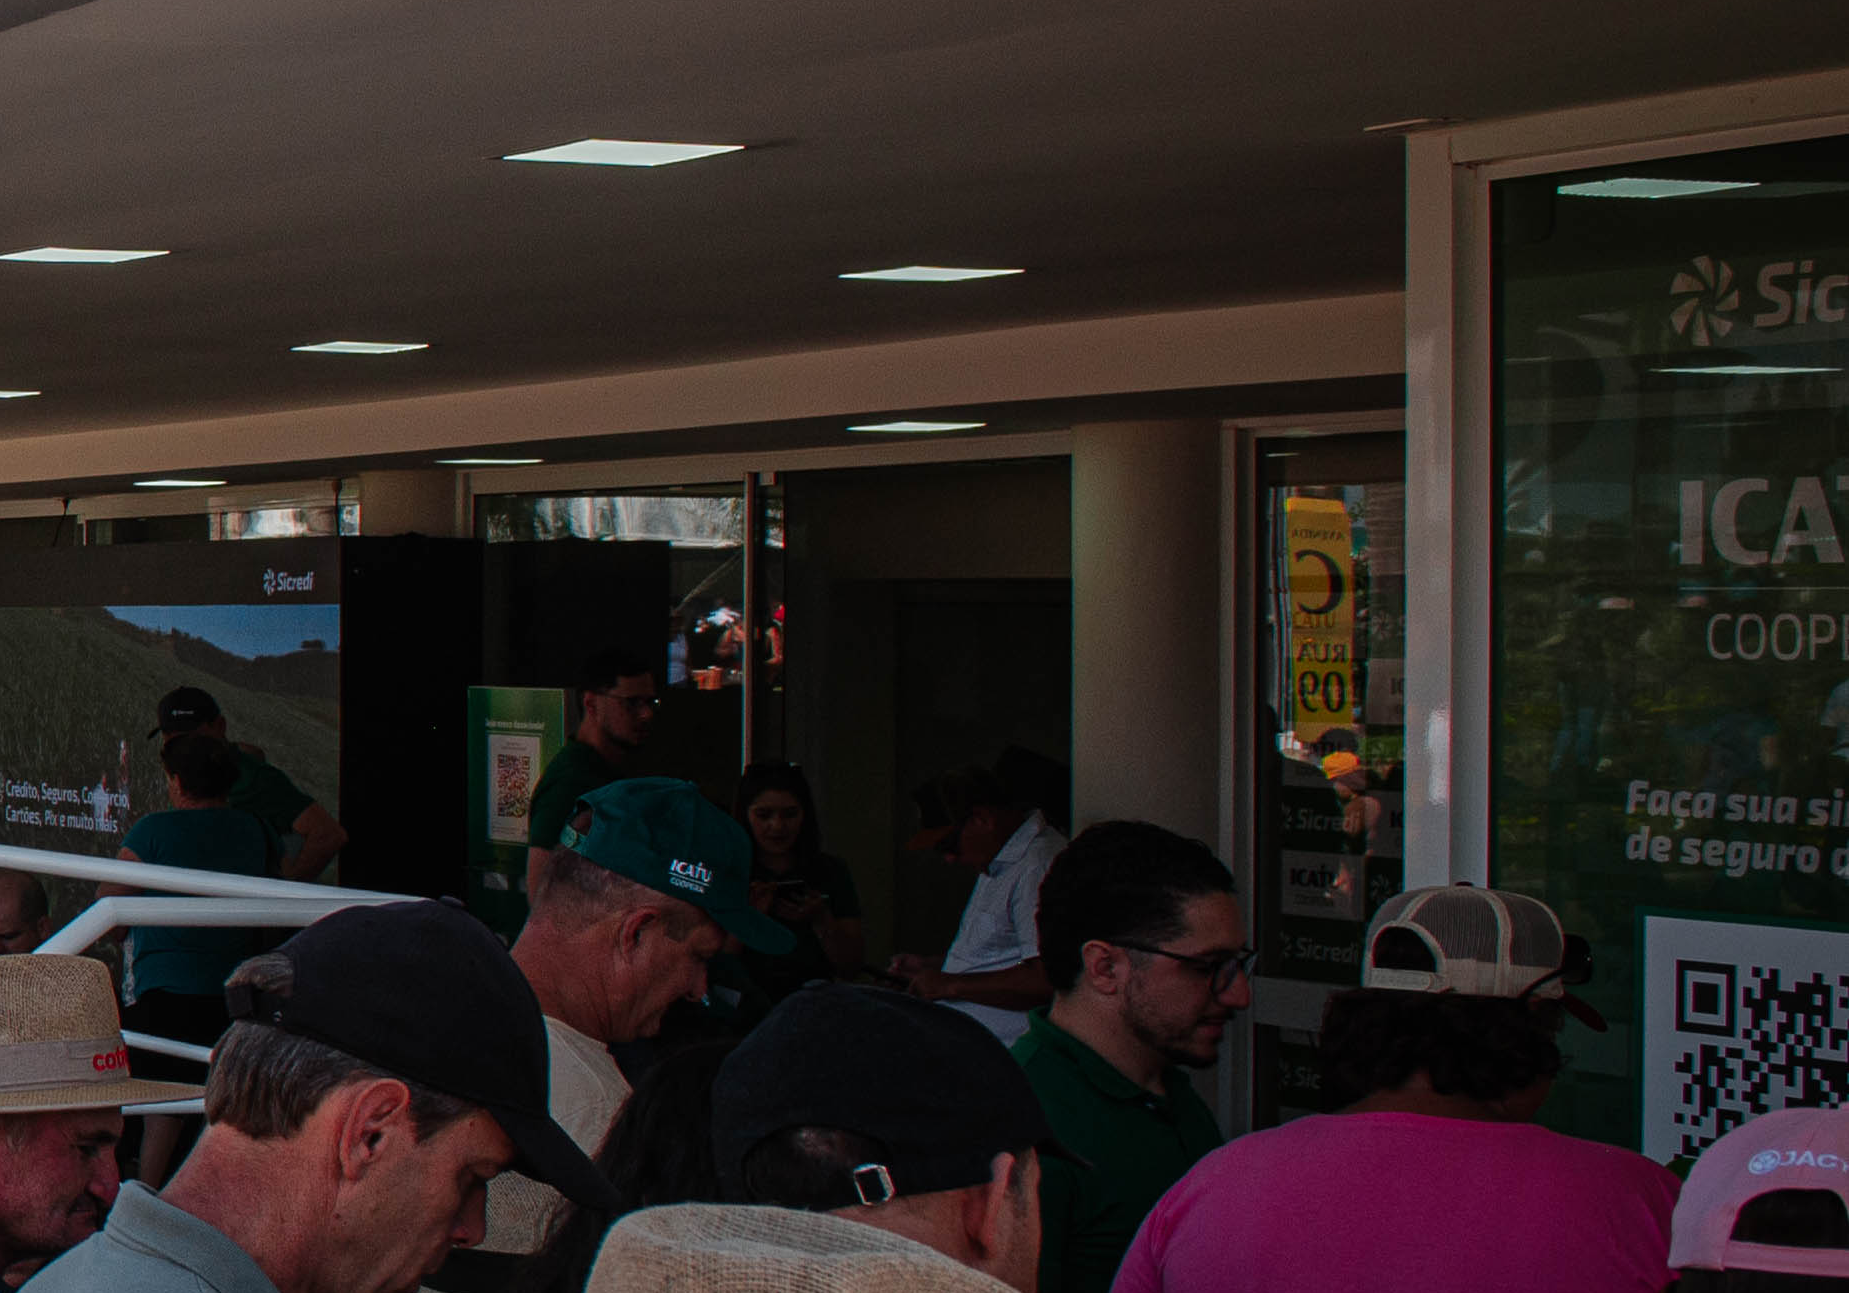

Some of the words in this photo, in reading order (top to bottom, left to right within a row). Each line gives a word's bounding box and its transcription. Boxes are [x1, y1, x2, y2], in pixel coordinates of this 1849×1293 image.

[1678, 475, 1849, 567] ICA
[276, 569, 315, 593] Sicredi
[1703, 612, 1849, 663] COOP
[5, 778, 41, 803] Crédito,
[41, 781, 81, 807] Seguros,
[81, 785, 131, 811] Corcio,
[1625, 778, 1718, 830] Faça
[1724, 792, 1800, 825] sua
[1806, 786, 1849, 827] si
[5, 803, 43, 827] Cartões,
[59, 813, 67, 827] e
[67, 811, 94, 831] muito
[1625, 824, 1673, 863] de
[1679, 836, 1822, 879] seguro
[1779, 1149, 1849, 1174] JAC
